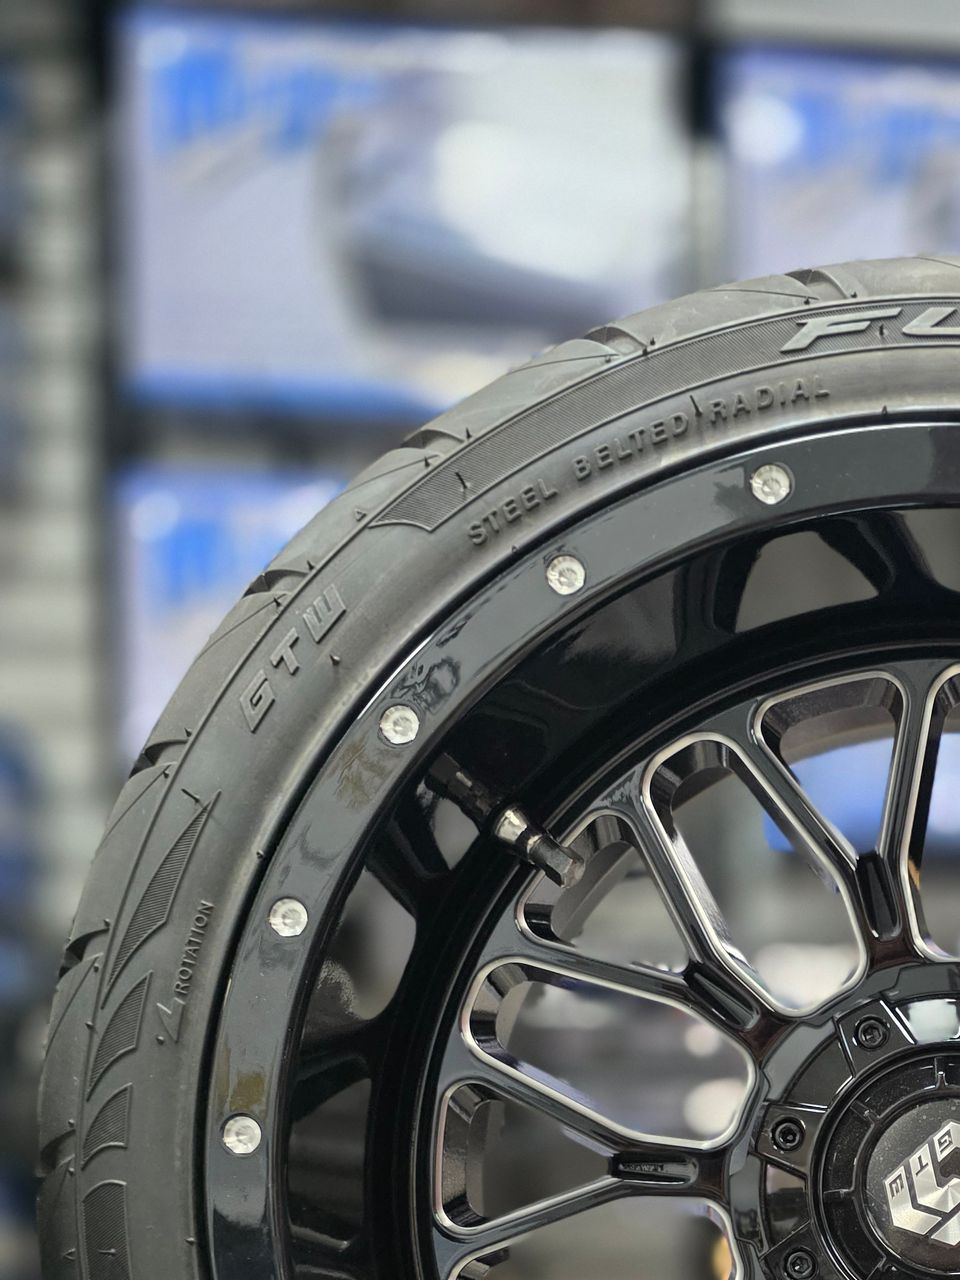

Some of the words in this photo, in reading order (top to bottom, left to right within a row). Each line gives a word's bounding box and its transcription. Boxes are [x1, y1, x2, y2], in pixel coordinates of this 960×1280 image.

[467, 483, 558, 547] STEEL
[575, 411, 688, 482] BELTED
[709, 374, 830, 425] RADIAL
[238, 585, 348, 733] GTW
[174, 899, 213, 995] ROTATION
